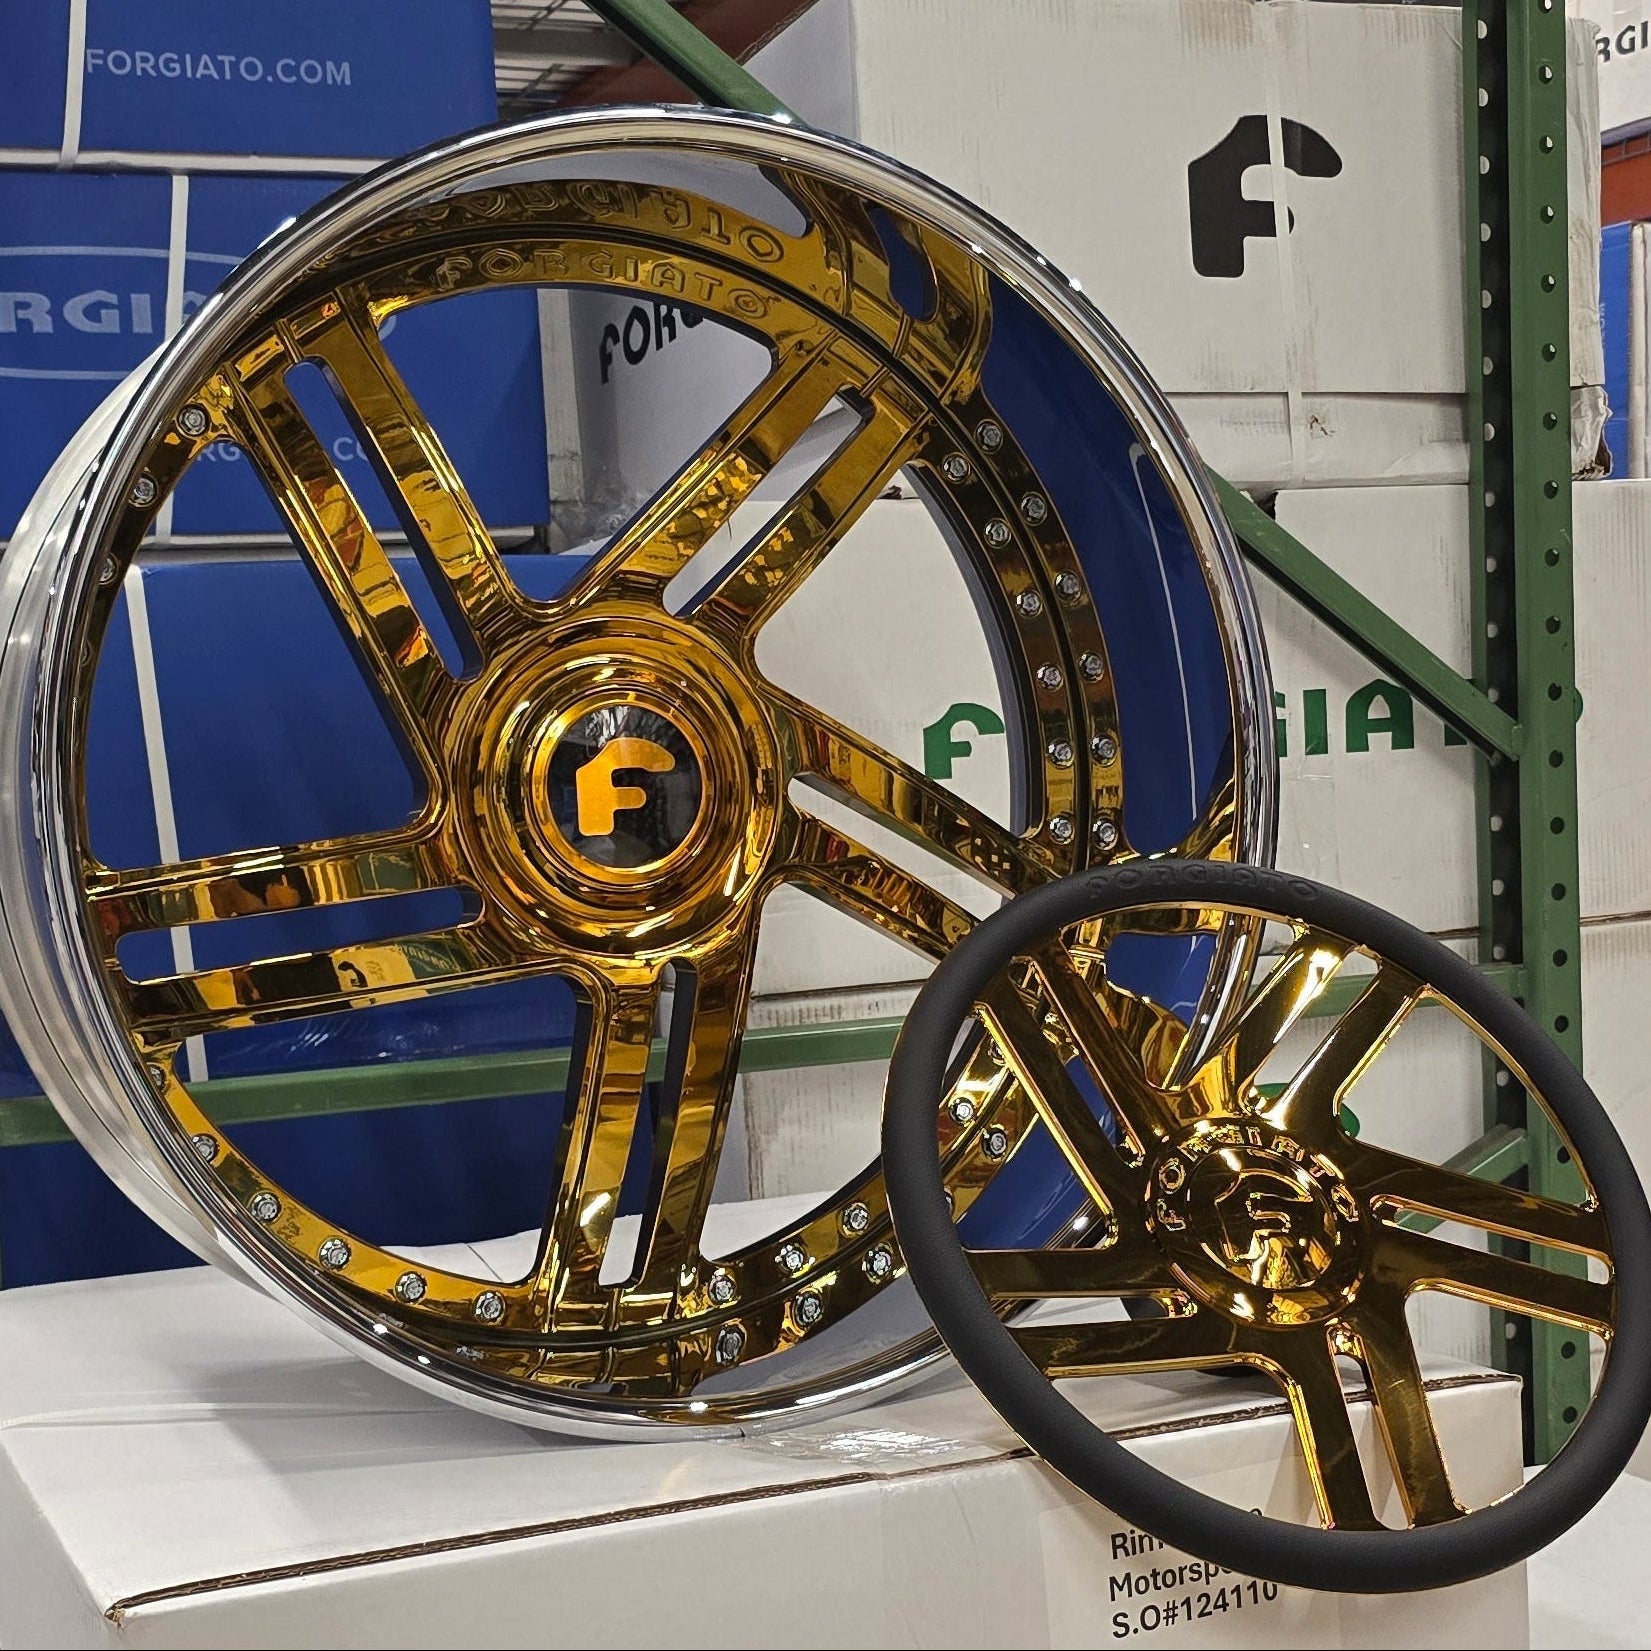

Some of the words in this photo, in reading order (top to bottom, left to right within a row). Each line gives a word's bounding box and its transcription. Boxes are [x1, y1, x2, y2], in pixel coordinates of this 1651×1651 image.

[85, 48, 351, 86] FORGIATO.COM
[435, 247, 768, 320] FORGIATO
[1088, 864, 1318, 900] FORGIATO
[1108, 1561, 1233, 1602] Motorsp
